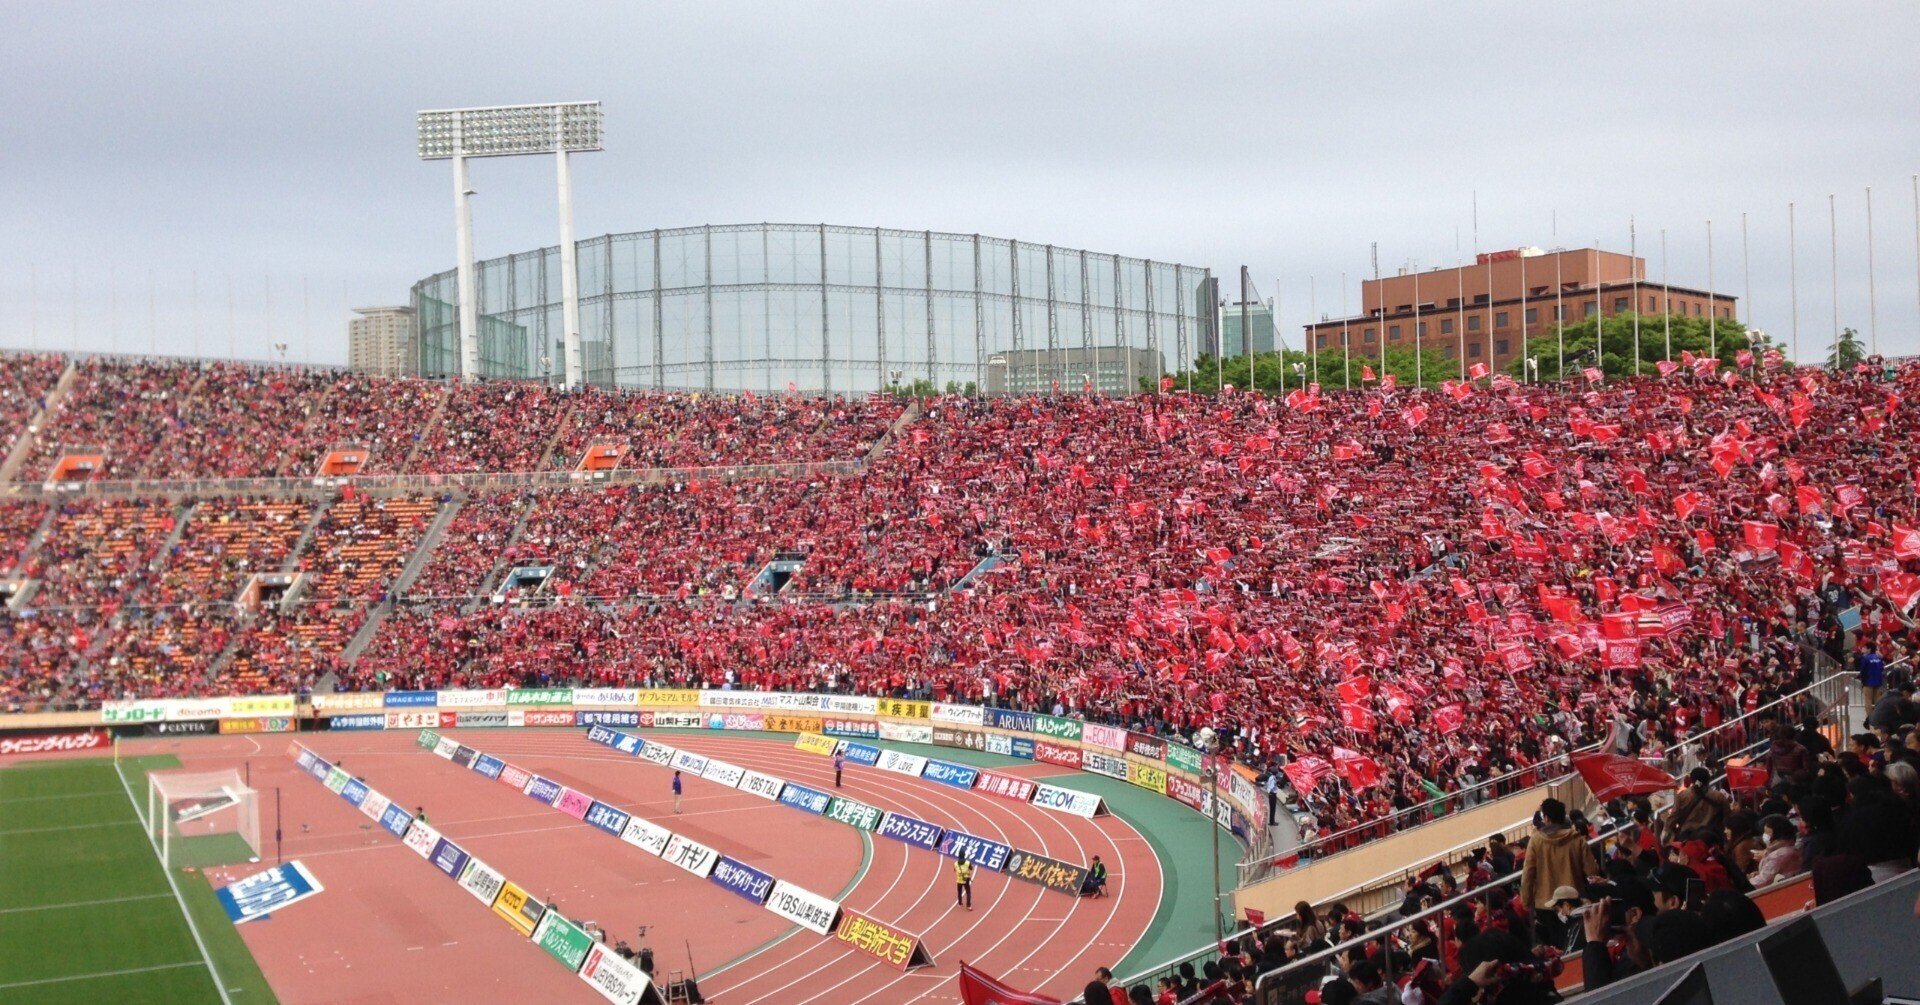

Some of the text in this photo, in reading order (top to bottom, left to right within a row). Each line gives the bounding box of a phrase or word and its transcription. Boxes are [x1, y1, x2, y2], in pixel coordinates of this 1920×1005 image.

[415, 695, 436, 703] WINE
[177, 708, 221, 716] docomo
[656, 717, 700, 726] 山梨トヨタ
[168, 723, 206, 732] CLYTIA
[749, 775, 777, 796] YBS T&L
[1036, 787, 1075, 810] SECOM
[828, 798, 877, 829] 文理学院
[885, 815, 935, 847] ネオシステム
[675, 842, 710, 870] オギノ
[777, 890, 831, 929] YBS山梨放送
[837, 913, 913, 965] 山梨学院大学
